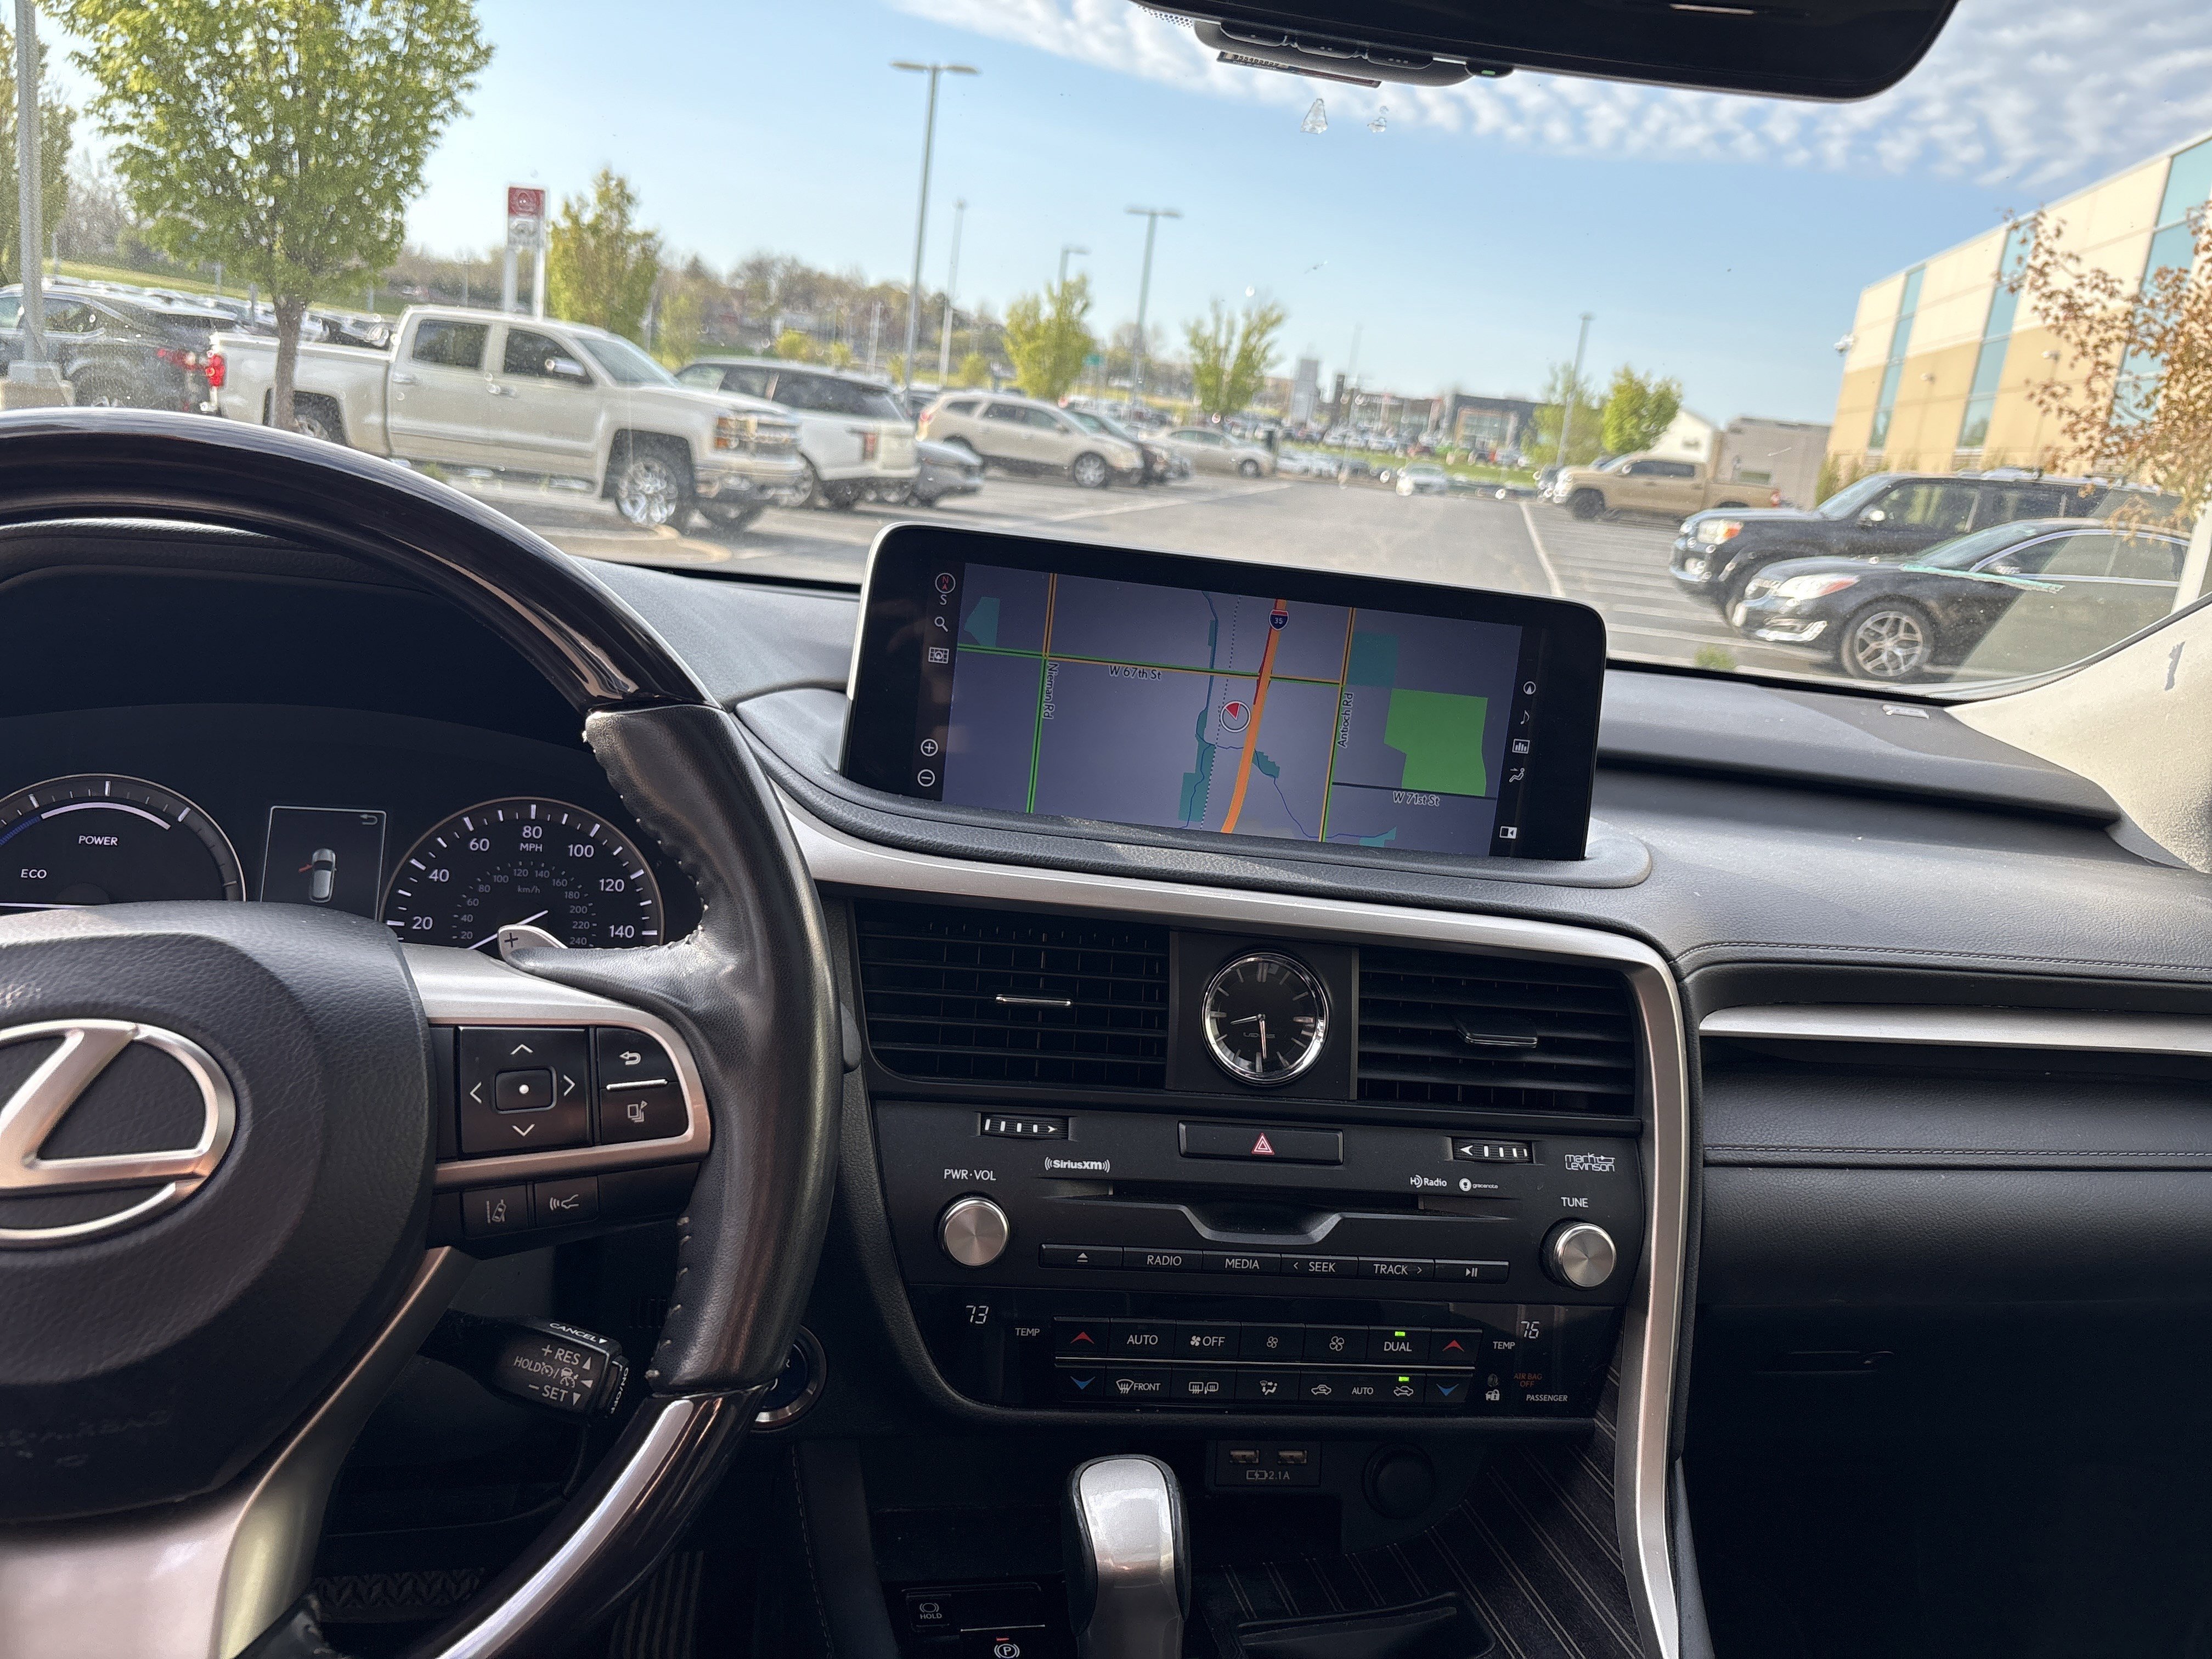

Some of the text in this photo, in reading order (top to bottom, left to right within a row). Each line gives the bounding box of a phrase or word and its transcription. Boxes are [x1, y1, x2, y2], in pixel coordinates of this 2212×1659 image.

[939, 594, 947, 606] S
[1272, 617, 1284, 625] 35
[1108, 665, 1162, 681] W 67th St
[1043, 662, 1059, 719] Nieman Rd
[1337, 692, 1353, 748] Antioch Rd
[1393, 792, 1440, 806] W 71st St
[522, 825, 543, 839] 80
[78, 835, 118, 846] POWER
[469, 838, 490, 851] 60
[520, 843, 543, 852] MPH
[568, 844, 594, 857] 100
[20, 868, 47, 879] ECO
[428, 868, 450, 882] 40
[513, 868, 529, 877] 120
[535, 870, 550, 878] 140
[493, 874, 509, 883] 100
[552, 878, 568, 887] 160
[478, 884, 491, 893] 80
[517, 885, 540, 894] km/h
[599, 878, 625, 892] 120
[564, 890, 580, 900] 180
[466, 897, 479, 907] 60
[569, 905, 588, 915] 200
[412, 916, 433, 930] 20
[460, 914, 473, 922] 40
[572, 921, 590, 929] 220
[460, 930, 473, 939] 20
[609, 924, 635, 938] 140
[569, 936, 588, 946] 240
[1423, 1176, 1448, 1188] Radio
[1560, 1197, 1589, 1208] TUNE
[1146, 1254, 1183, 1267] RADIO
[1224, 1257, 1260, 1270] MEDIA
[1308, 1261, 1336, 1273] SEEK
[1373, 1263, 1409, 1276] TRACK
[966, 1305, 989, 1324] 73
[549, 1322, 598, 1343] CANCEL
[1015, 1328, 1040, 1336] TEMP
[1520, 1321, 1540, 1339] 76
[1126, 1334, 1158, 1345] AUTO
[1202, 1336, 1226, 1347] OFF
[1384, 1341, 1412, 1352] DUAL
[1493, 1341, 1516, 1350] TEMP
[554, 1347, 582, 1366] RES
[513, 1355, 542, 1373] HOLD
[1513, 1372, 1543, 1381] AIR BAG
[610, 1367, 630, 1415] ON/OFF
[1133, 1381, 1161, 1392] FRONT
[1351, 1387, 1374, 1395] AUTO
[541, 1384, 569, 1403] SET
[1268, 1470, 1291, 1480] 2.1A
[1003, 1646, 1012, 1656] P
